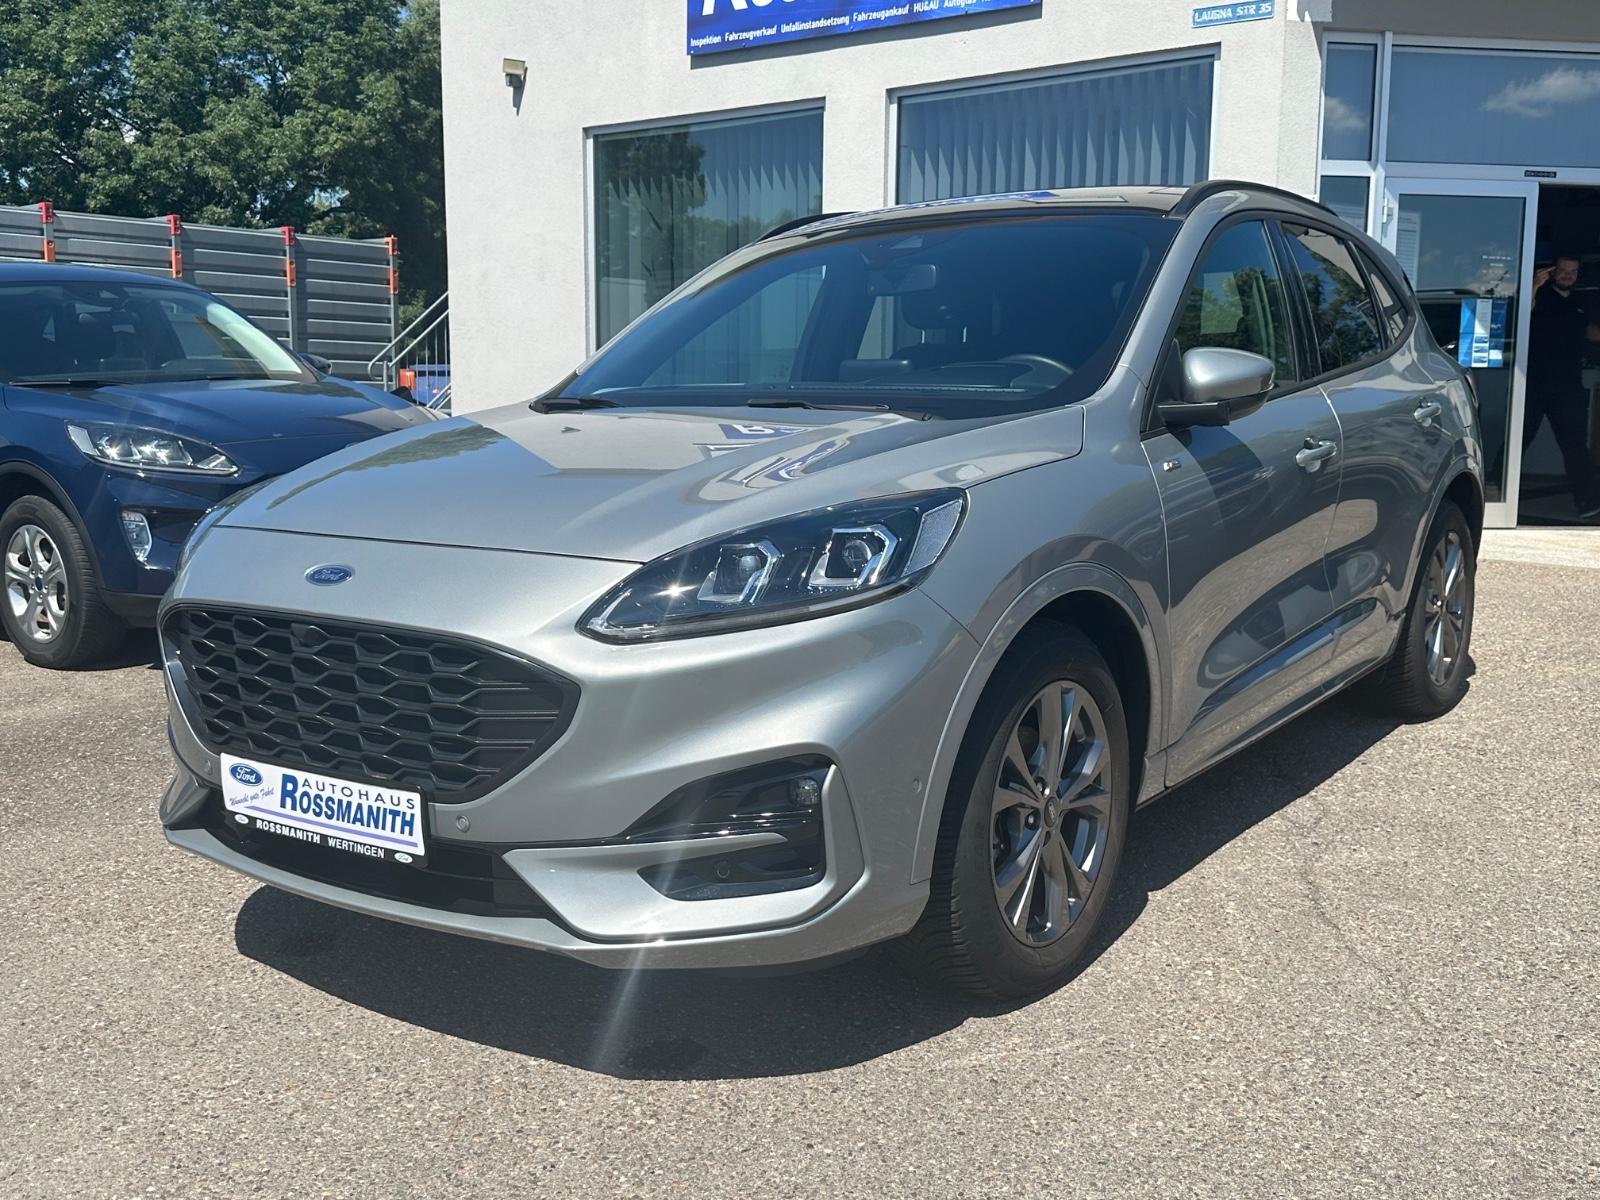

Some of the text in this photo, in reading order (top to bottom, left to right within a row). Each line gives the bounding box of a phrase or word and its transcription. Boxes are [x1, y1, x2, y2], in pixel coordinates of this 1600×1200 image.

[690, 34, 722, 48] Inspektion
[725, 25, 777, 40] Fahrzeugverkauf
[781, 16, 849, 33] Unfallinstandsetzung
[853, 5, 909, 21] Fahrzeugankauf
[913, 2, 938, 13] HU&AU
[280, 773, 415, 837] ROSSMANITH
[302, 778, 415, 809] AUTOHAUS
[256, 818, 385, 859] ROSSMANITH WERTINGEN
